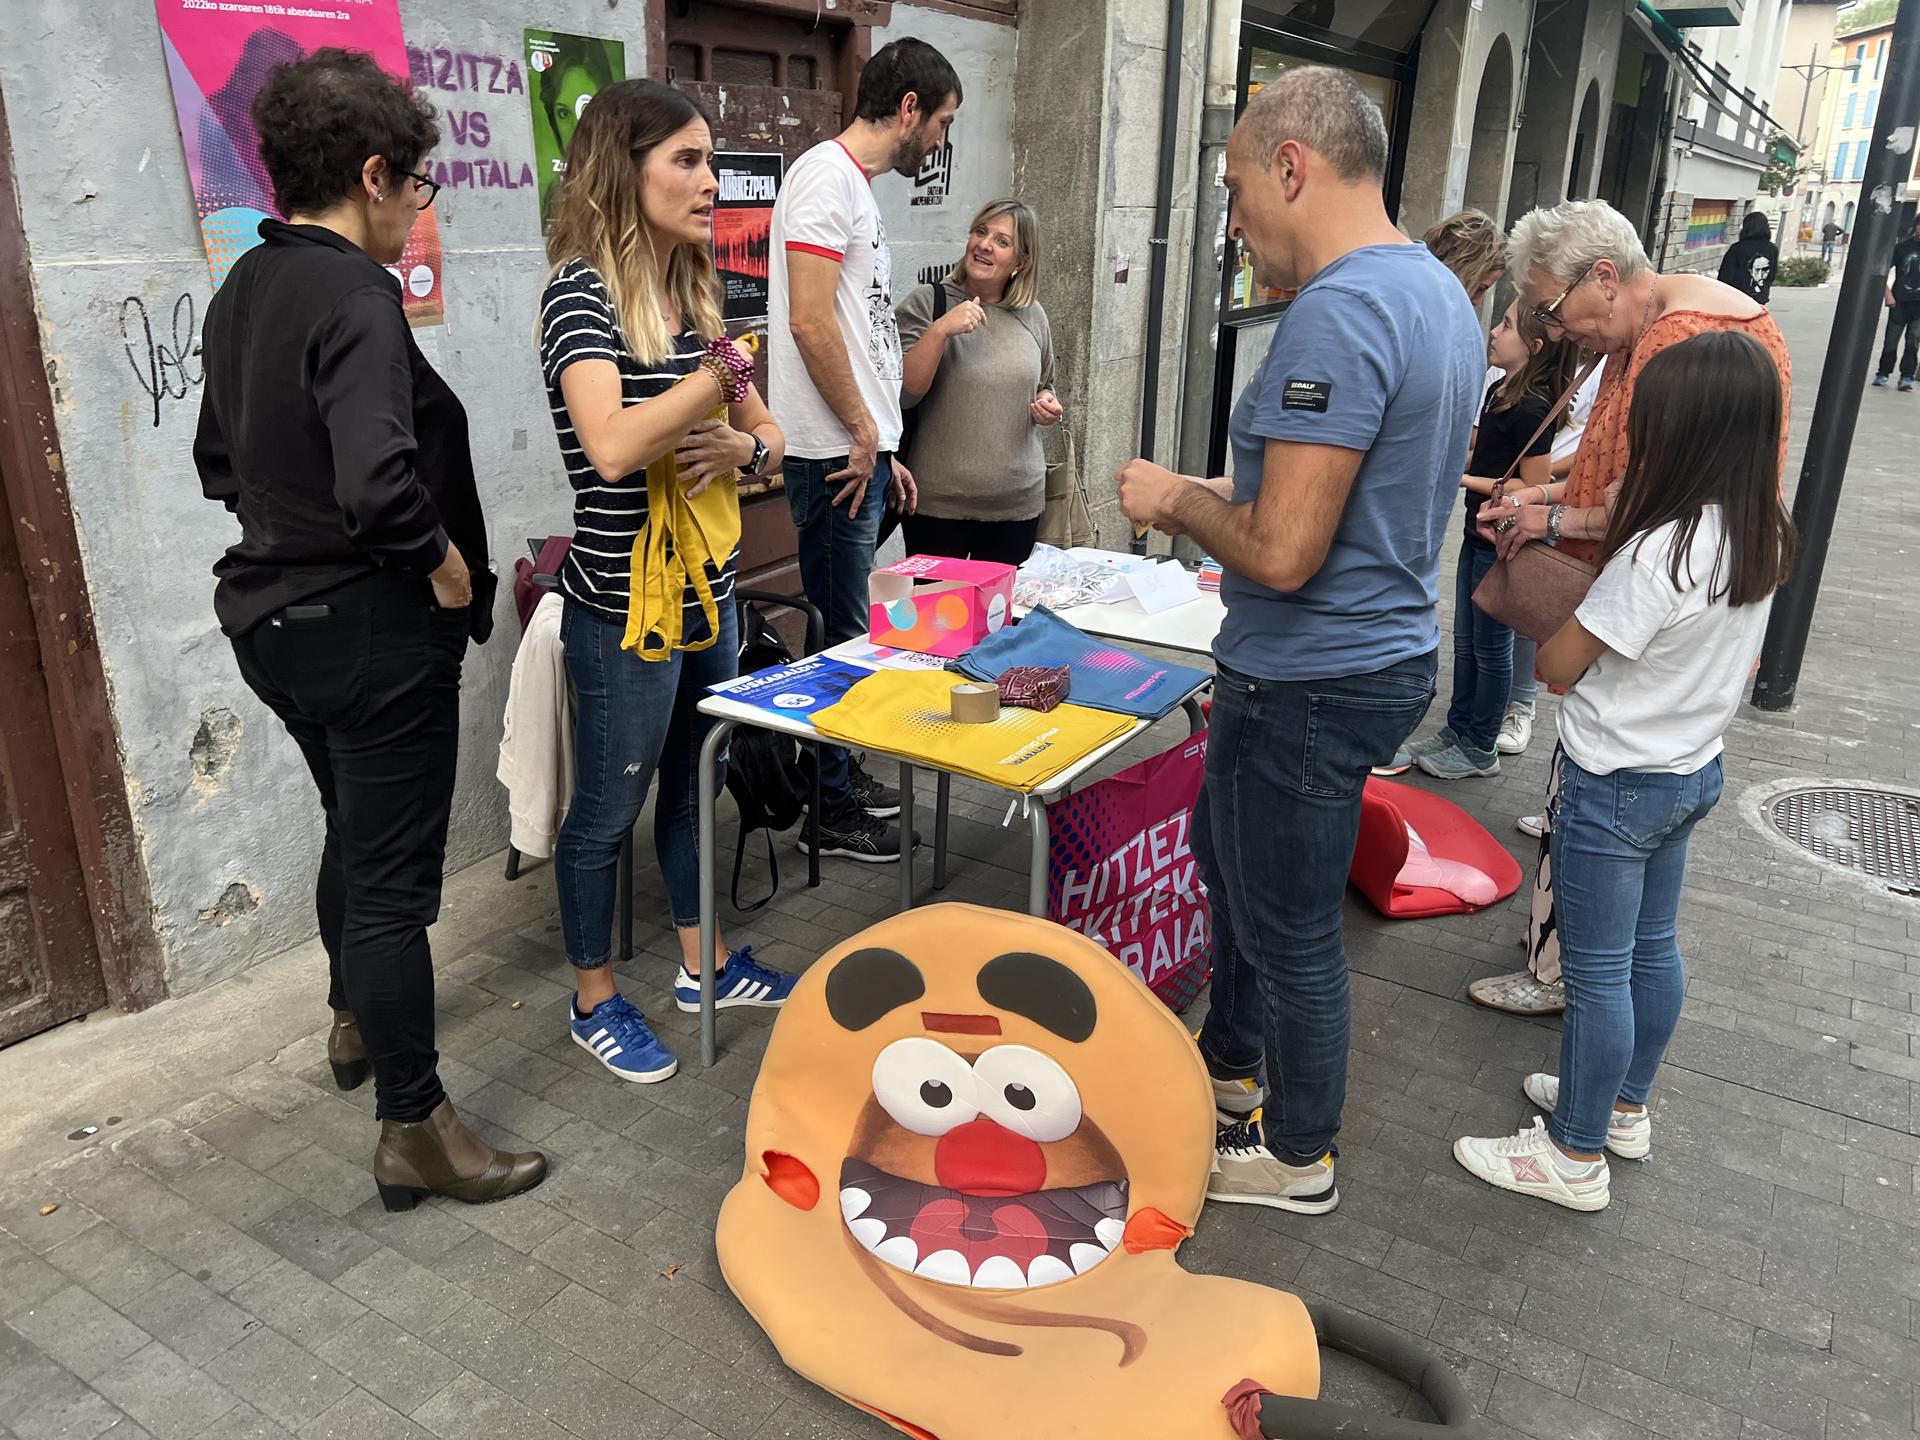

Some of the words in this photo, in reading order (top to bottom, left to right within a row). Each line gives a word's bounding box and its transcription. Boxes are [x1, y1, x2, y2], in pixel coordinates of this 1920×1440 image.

[182, 0, 218, 10] 2022ko
[218, 4, 264, 14] azaroaren
[264, 4, 286, 15] 18tik
[286, 7, 336, 19] abenduaren
[336, 10, 351, 21] 2ra
[447, 110, 491, 148] VS
[718, 175, 776, 201] AURKEZPENA
[727, 662, 826, 694] EUSKARALDIA
[1061, 808, 1193, 918] HITZEZ
[1063, 860, 1208, 950] KITEK
[1120, 909, 1207, 985] RAIA
